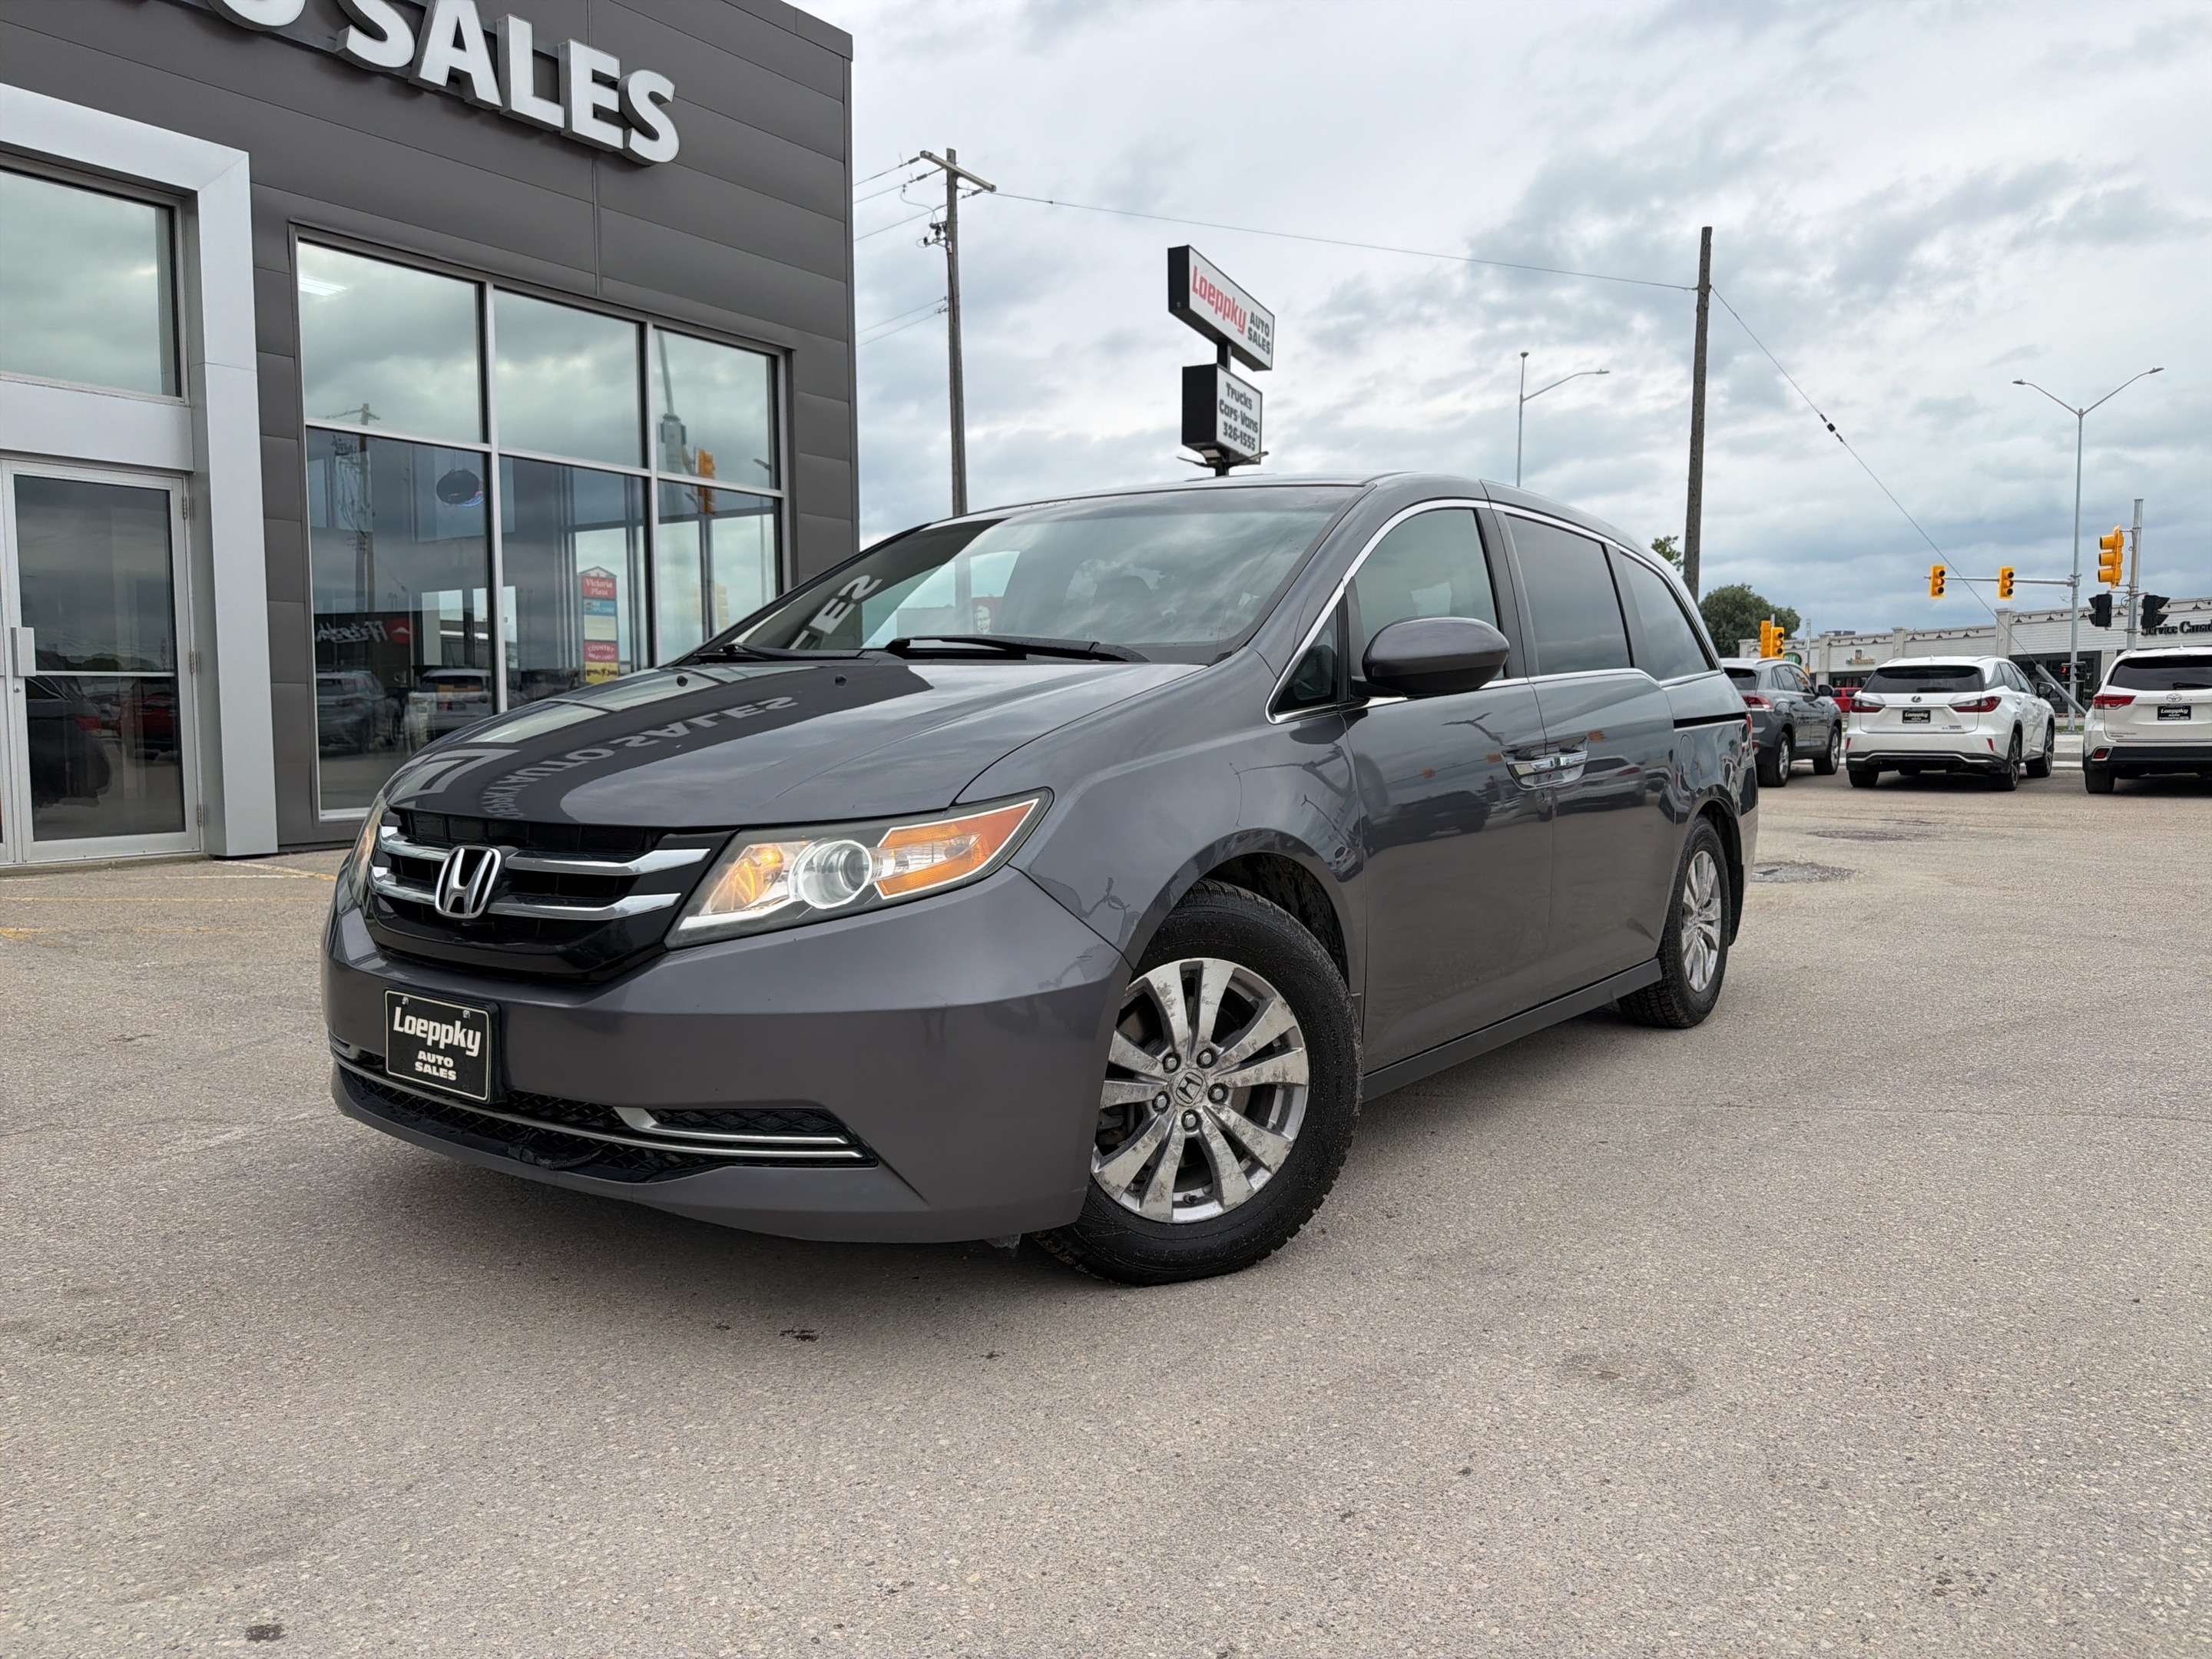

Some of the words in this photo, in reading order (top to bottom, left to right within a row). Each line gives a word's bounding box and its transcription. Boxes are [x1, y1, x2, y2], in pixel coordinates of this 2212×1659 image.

[338, 0, 680, 164] SALES
[1192, 265, 1247, 336] Loeppky
[1250, 311, 1270, 338] AUTO
[1247, 326, 1270, 355] SALES
[1226, 382, 1253, 411] Trucks
[1223, 421, 1256, 452] 326-1555
[393, 1006, 482, 1057] Loeppky
[415, 1061, 456, 1081] SALES
[417, 1050, 454, 1068] AUTO
